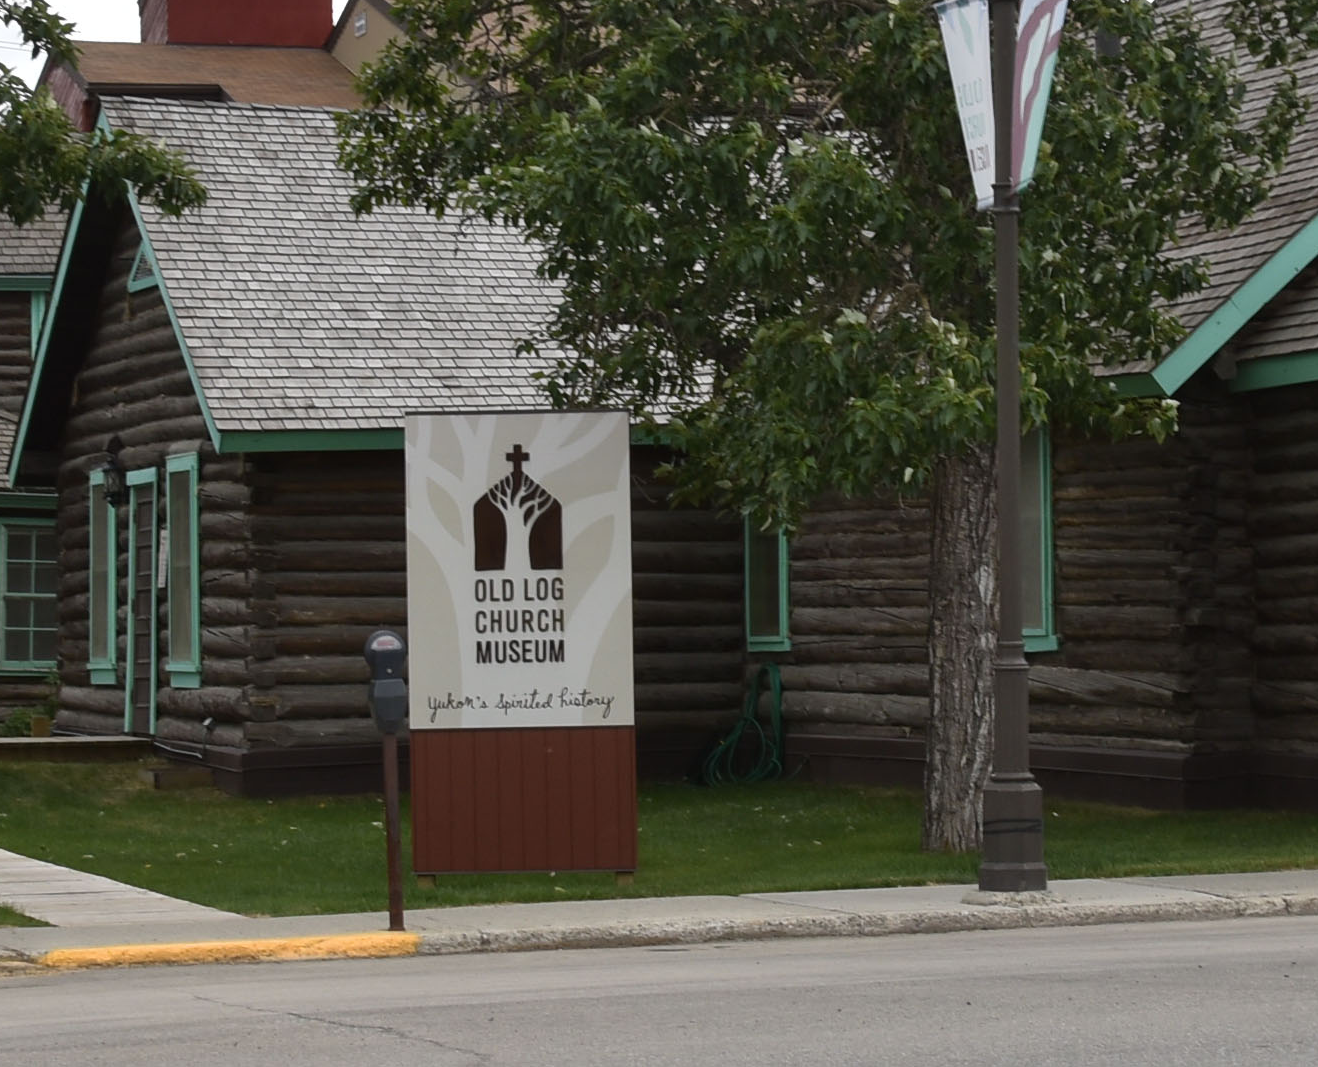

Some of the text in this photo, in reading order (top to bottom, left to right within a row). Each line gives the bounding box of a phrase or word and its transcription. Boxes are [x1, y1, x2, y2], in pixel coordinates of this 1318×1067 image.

[475, 577, 564, 602] OLD LOG
[475, 609, 565, 634] CHURCH
[476, 639, 565, 664] MUSEUM
[557, 686, 615, 719] history
